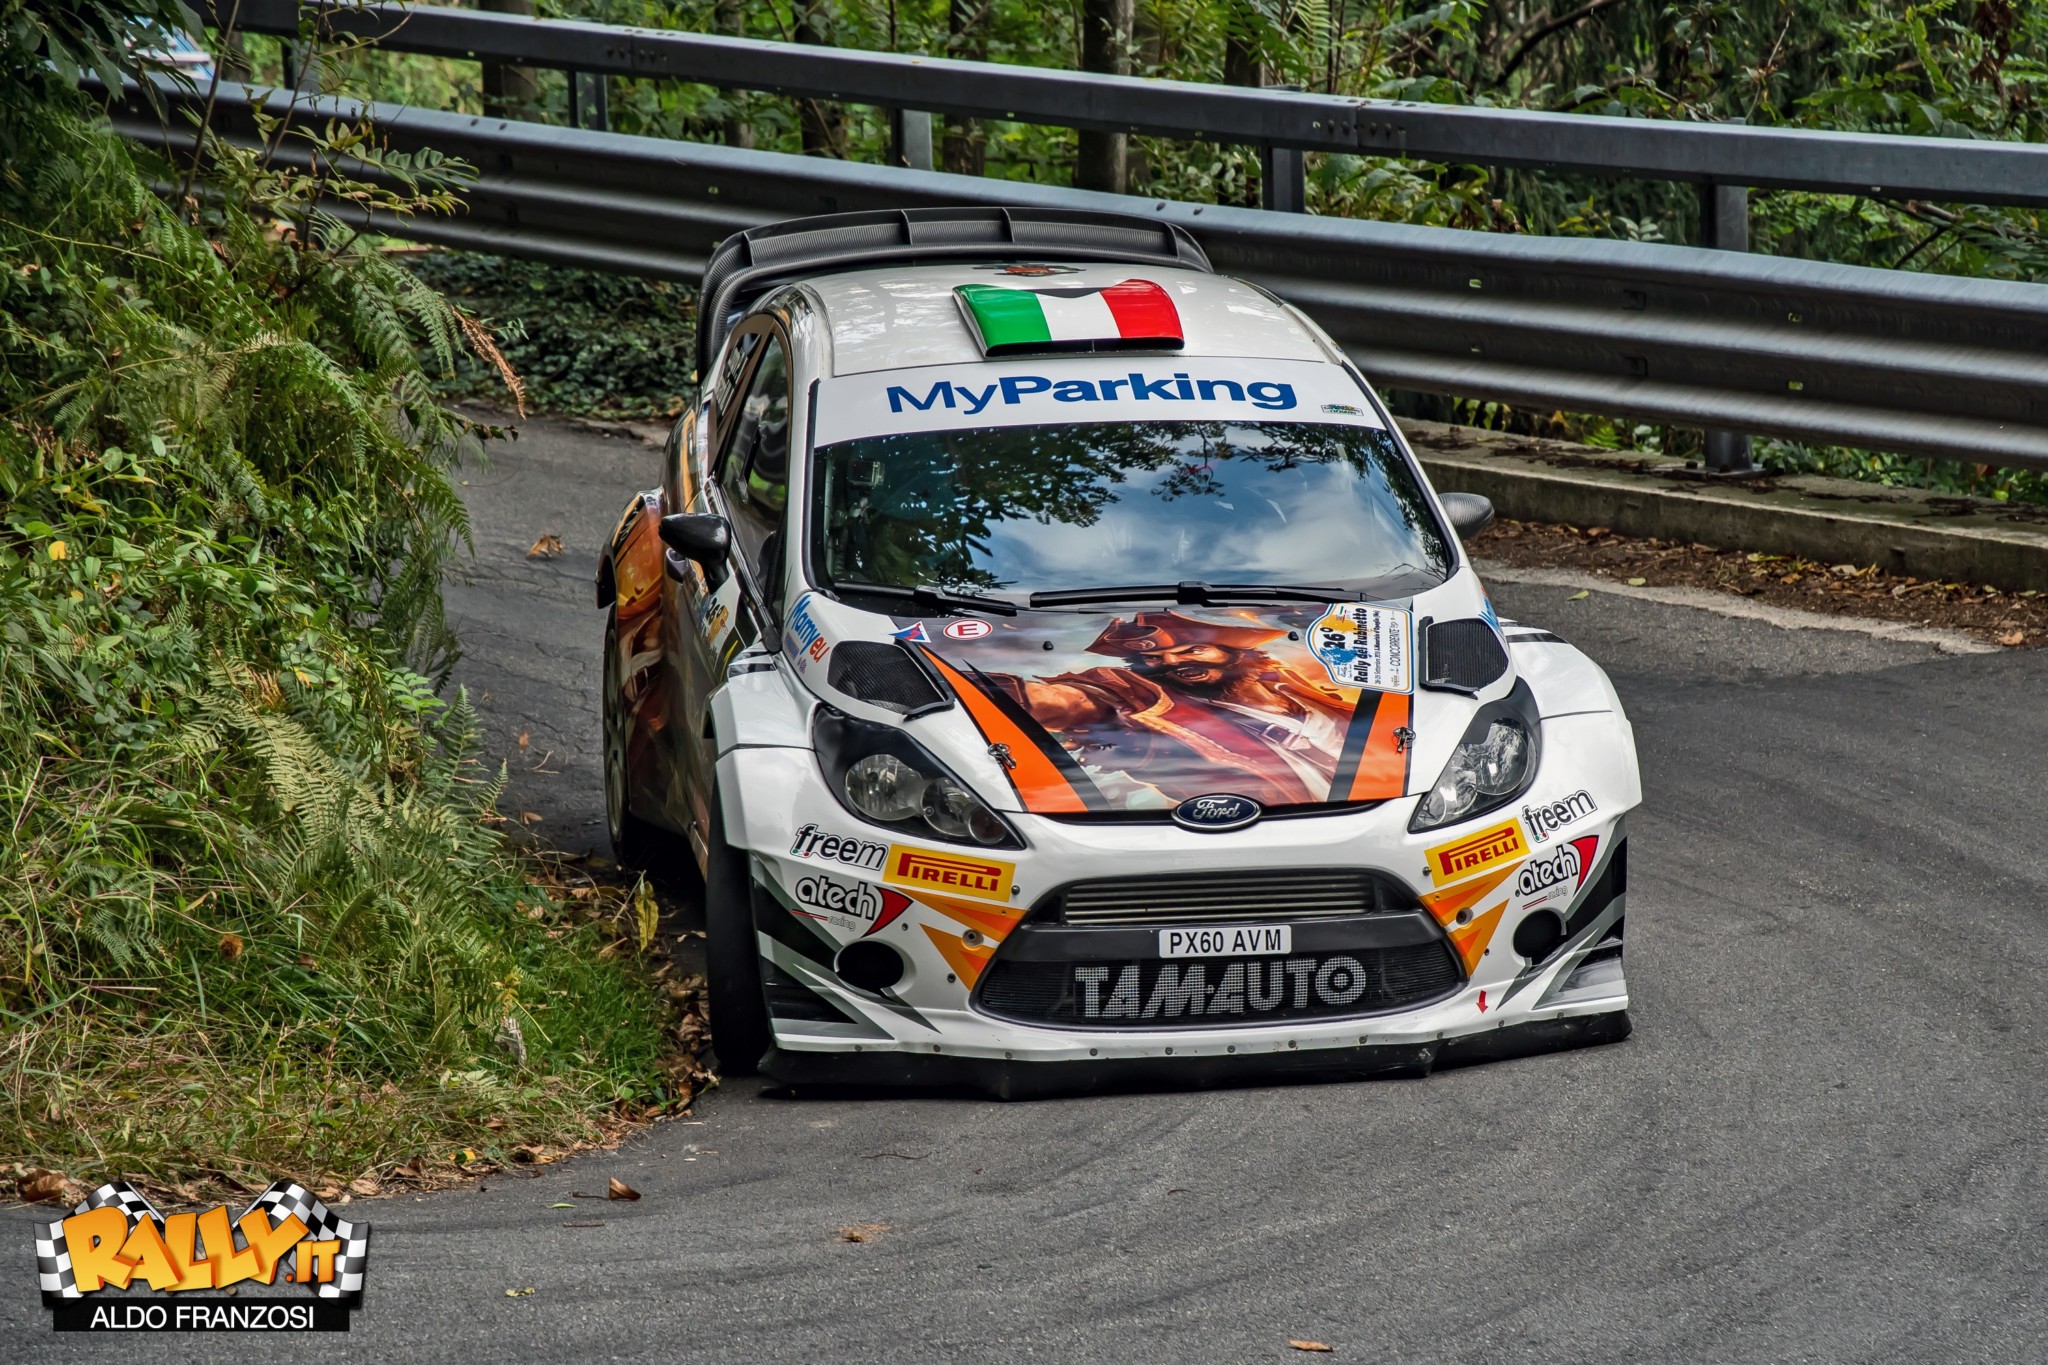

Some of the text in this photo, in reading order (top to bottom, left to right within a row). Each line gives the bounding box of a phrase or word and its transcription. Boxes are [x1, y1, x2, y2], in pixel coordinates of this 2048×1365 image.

[886, 372, 1298, 415] MyParking
[957, 623, 979, 636] E
[1352, 607, 1372, 683] Rally del Rubinetto
[1388, 628, 1401, 667] CONCORRENTE
[1192, 799, 1241, 819] Ford
[1523, 790, 1596, 841] freem
[792, 824, 887, 870] freem
[1438, 827, 1519, 876] PIRELLI
[1518, 843, 1578, 896] atech
[897, 852, 1002, 892] PIRELLI
[795, 875, 877, 921] atech
[1169, 929, 1281, 954] PX60 AVM
[1074, 956, 1366, 1018] TAMAUTO
